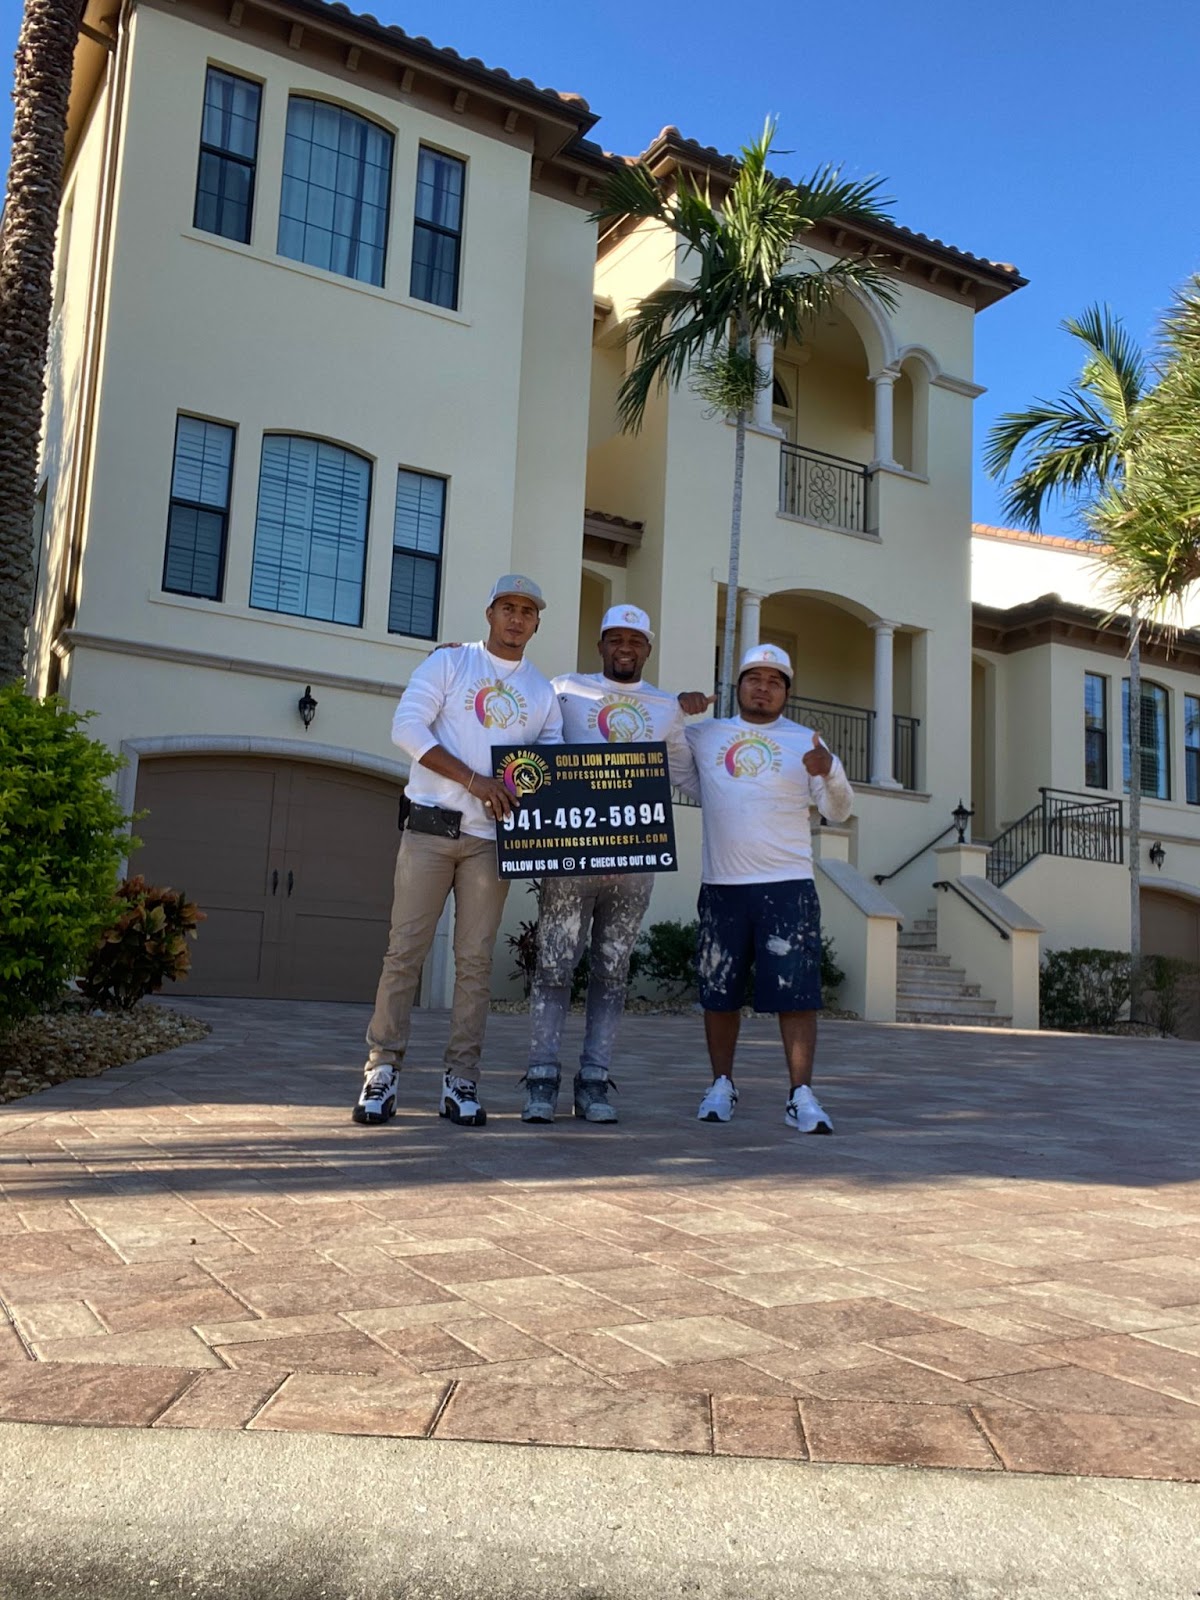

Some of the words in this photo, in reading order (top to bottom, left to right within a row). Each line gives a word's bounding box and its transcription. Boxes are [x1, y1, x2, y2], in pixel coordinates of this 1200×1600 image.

[465, 688, 477, 711] GOLD
[519, 712, 528, 727] INC
[500, 753, 516, 768] LION
[517, 750, 549, 771] PAINTING
[543, 772, 552, 786] INC
[555, 754, 580, 767] GOLD
[581, 753, 603, 766] LION
[604, 752, 646, 766] PAINTING
[647, 752, 664, 765] INC
[556, 769, 621, 781] PROFESSIONAL
[624, 767, 666, 778] PAINTING
[590, 779, 633, 790] SERVICES
[503, 802, 666, 831] 941-462-5894
[504, 833, 668, 850] LIONPAINTINGSERVICESFL.COM
[502, 859, 534, 872] FOLLOW
[535, 859, 546, 871] US
[547, 859, 559, 870] ON
[590, 856, 617, 868] CHECK
[617, 855, 628, 867] US
[629, 855, 645, 867] OUT
[646, 854, 657, 866] ON
